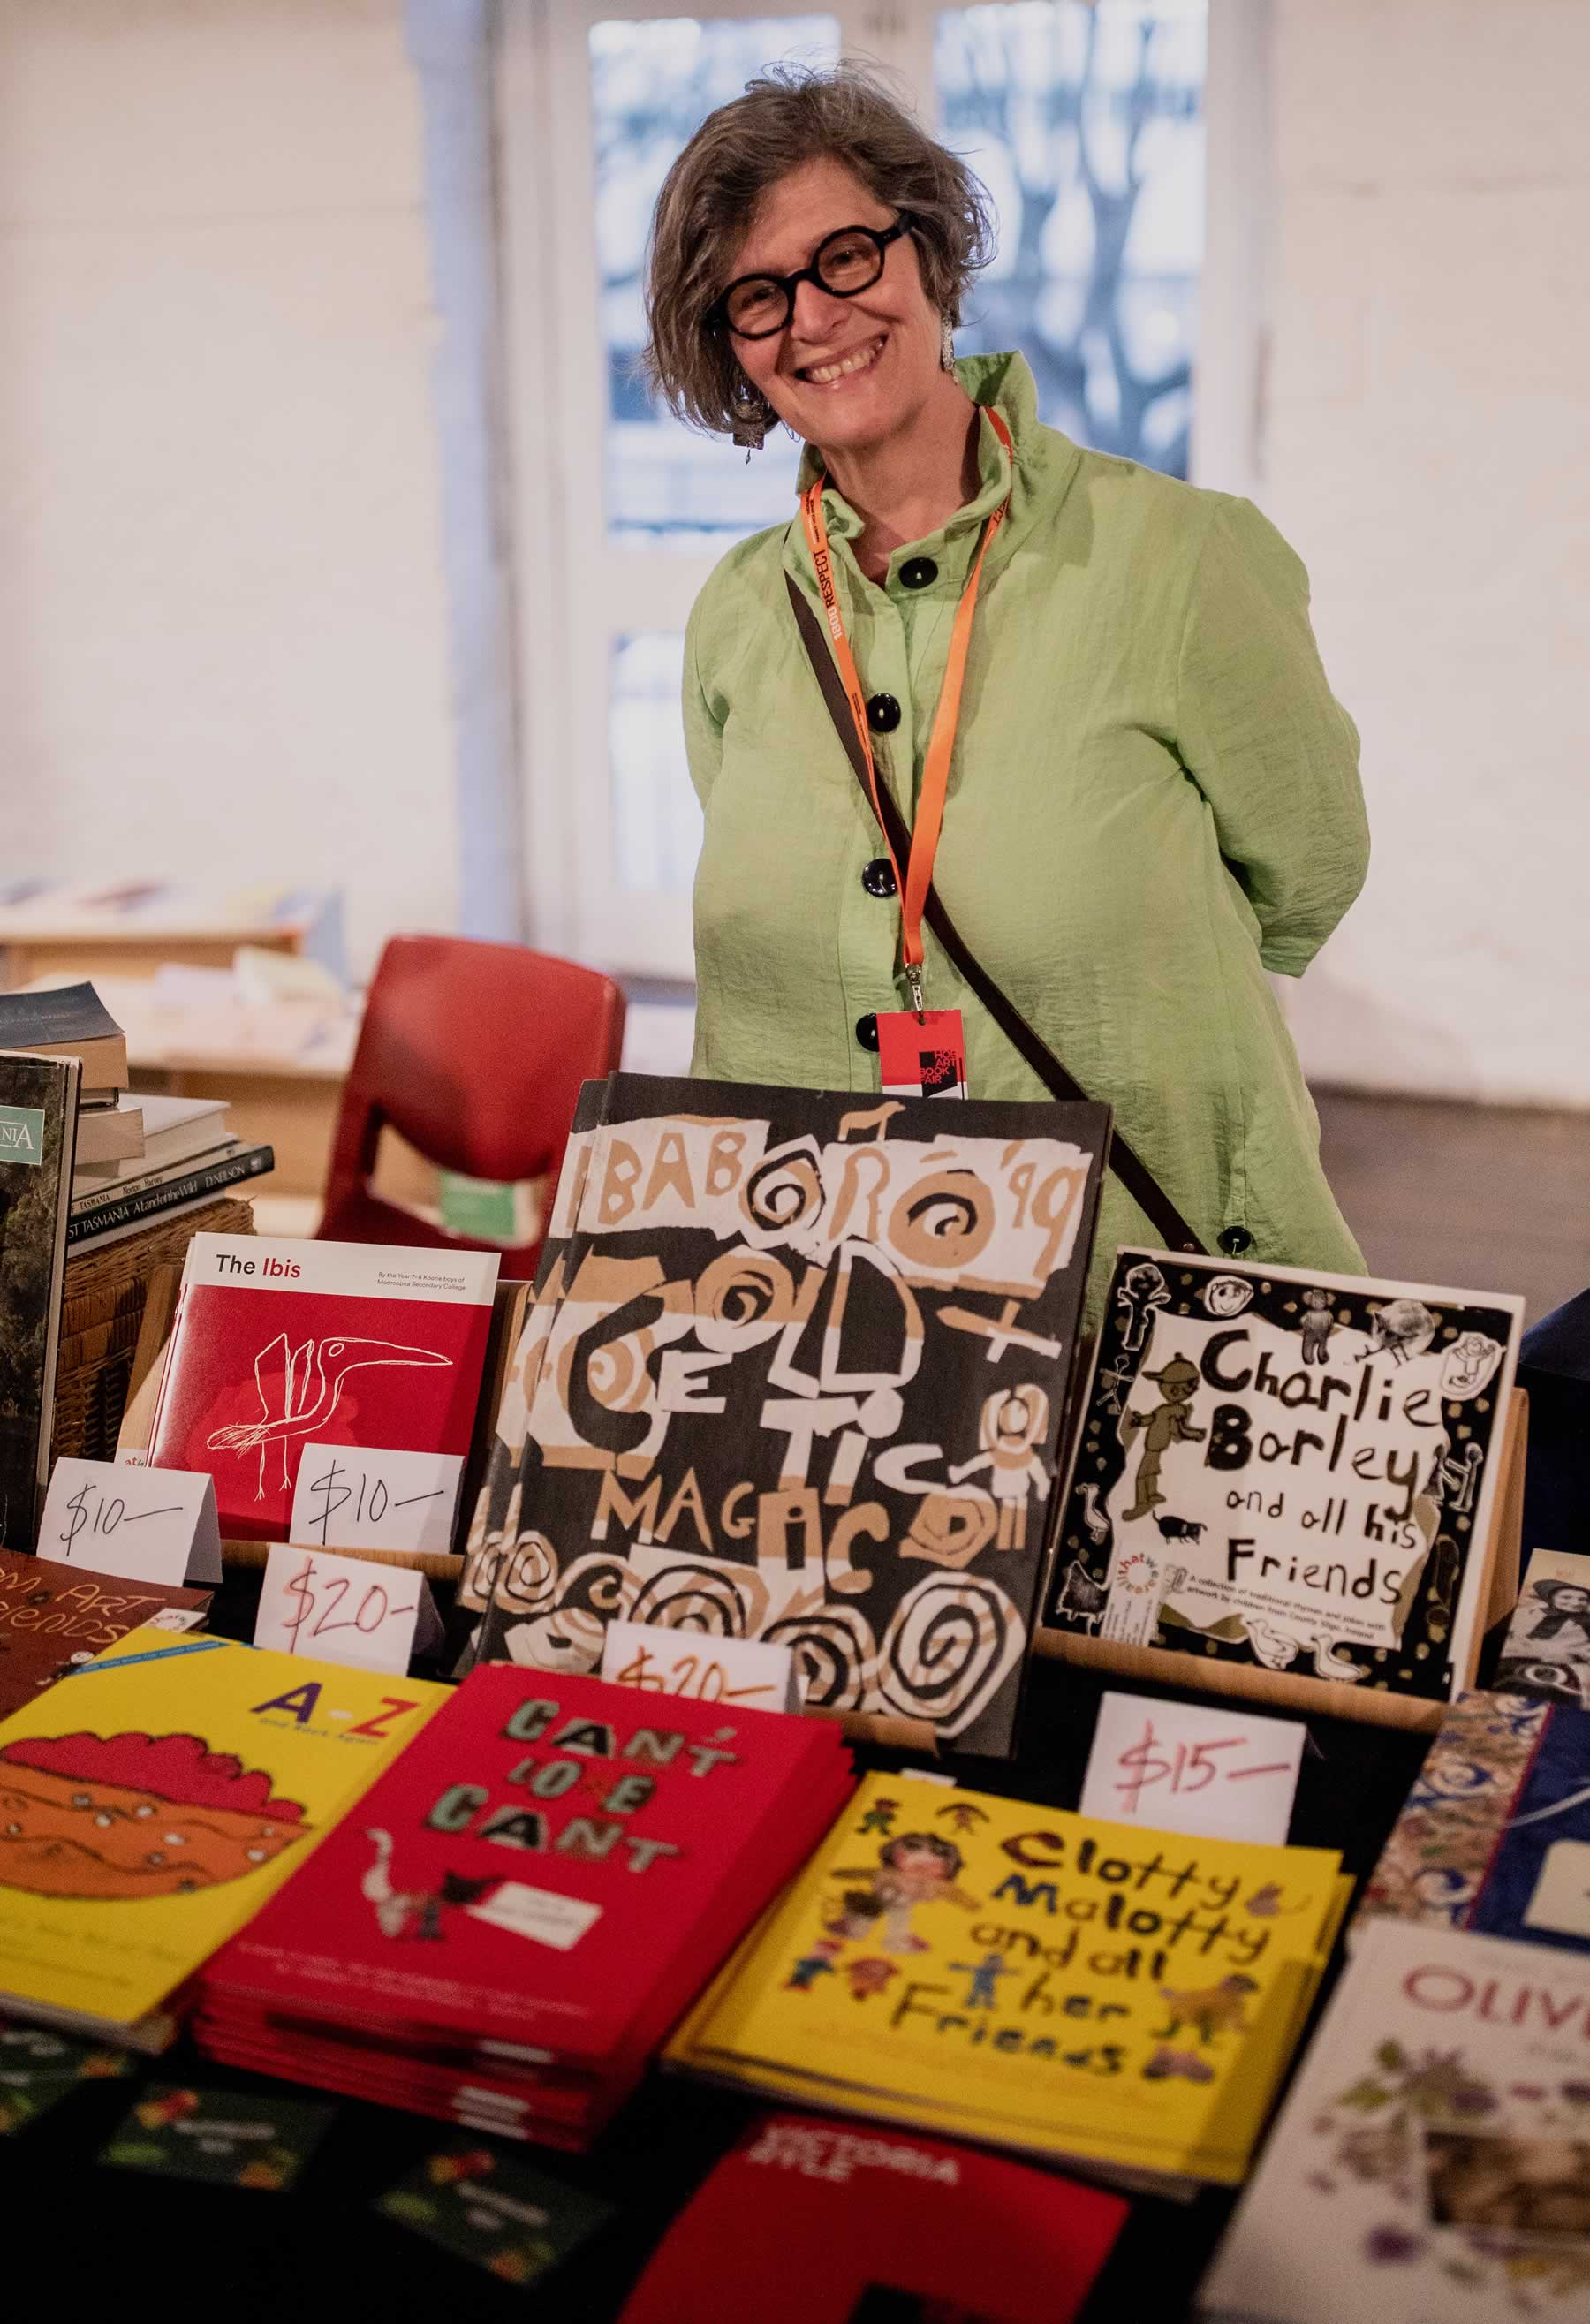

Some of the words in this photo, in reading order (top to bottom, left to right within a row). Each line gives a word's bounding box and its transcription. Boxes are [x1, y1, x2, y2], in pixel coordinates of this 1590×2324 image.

[919, 1067, 950, 1076] BOOK
[0, 1124, 35, 1150] NIA
[68, 1223, 80, 1238] ST
[81, 1207, 130, 1231] TASMANIA
[80, 1194, 110, 1210] TASMANIA
[216, 1253, 256, 1276] The
[262, 1257, 302, 1279] Ibis
[412, 1281, 442, 1290] Secondary
[1200, 1329, 1442, 1427] Charlie
[1226, 1490, 1284, 1518] and
[1301, 1497, 1347, 1535] all
[1364, 1503, 1417, 1548] his
[1227, 1538, 1402, 1604] Friends
[55, 1584, 166, 1616] ART
[1233, 1598, 1265, 1610] children
[1268, 1607, 1286, 1616] from
[1290, 1613, 1317, 1625] County
[1250, 1592, 1290, 1607] traditional
[1293, 1602, 1322, 1614] rhymes
[1000, 1831, 1240, 1911] Clotty
[991, 1874, 1270, 1966] Malotty
[971, 1923, 1079, 1970] and
[1087, 1949, 1168, 1982] all
[1021, 1972, 1131, 2023] her
[1399, 1963, 1590, 2039] OLIV
[890, 1981, 1126, 2077] Friends
